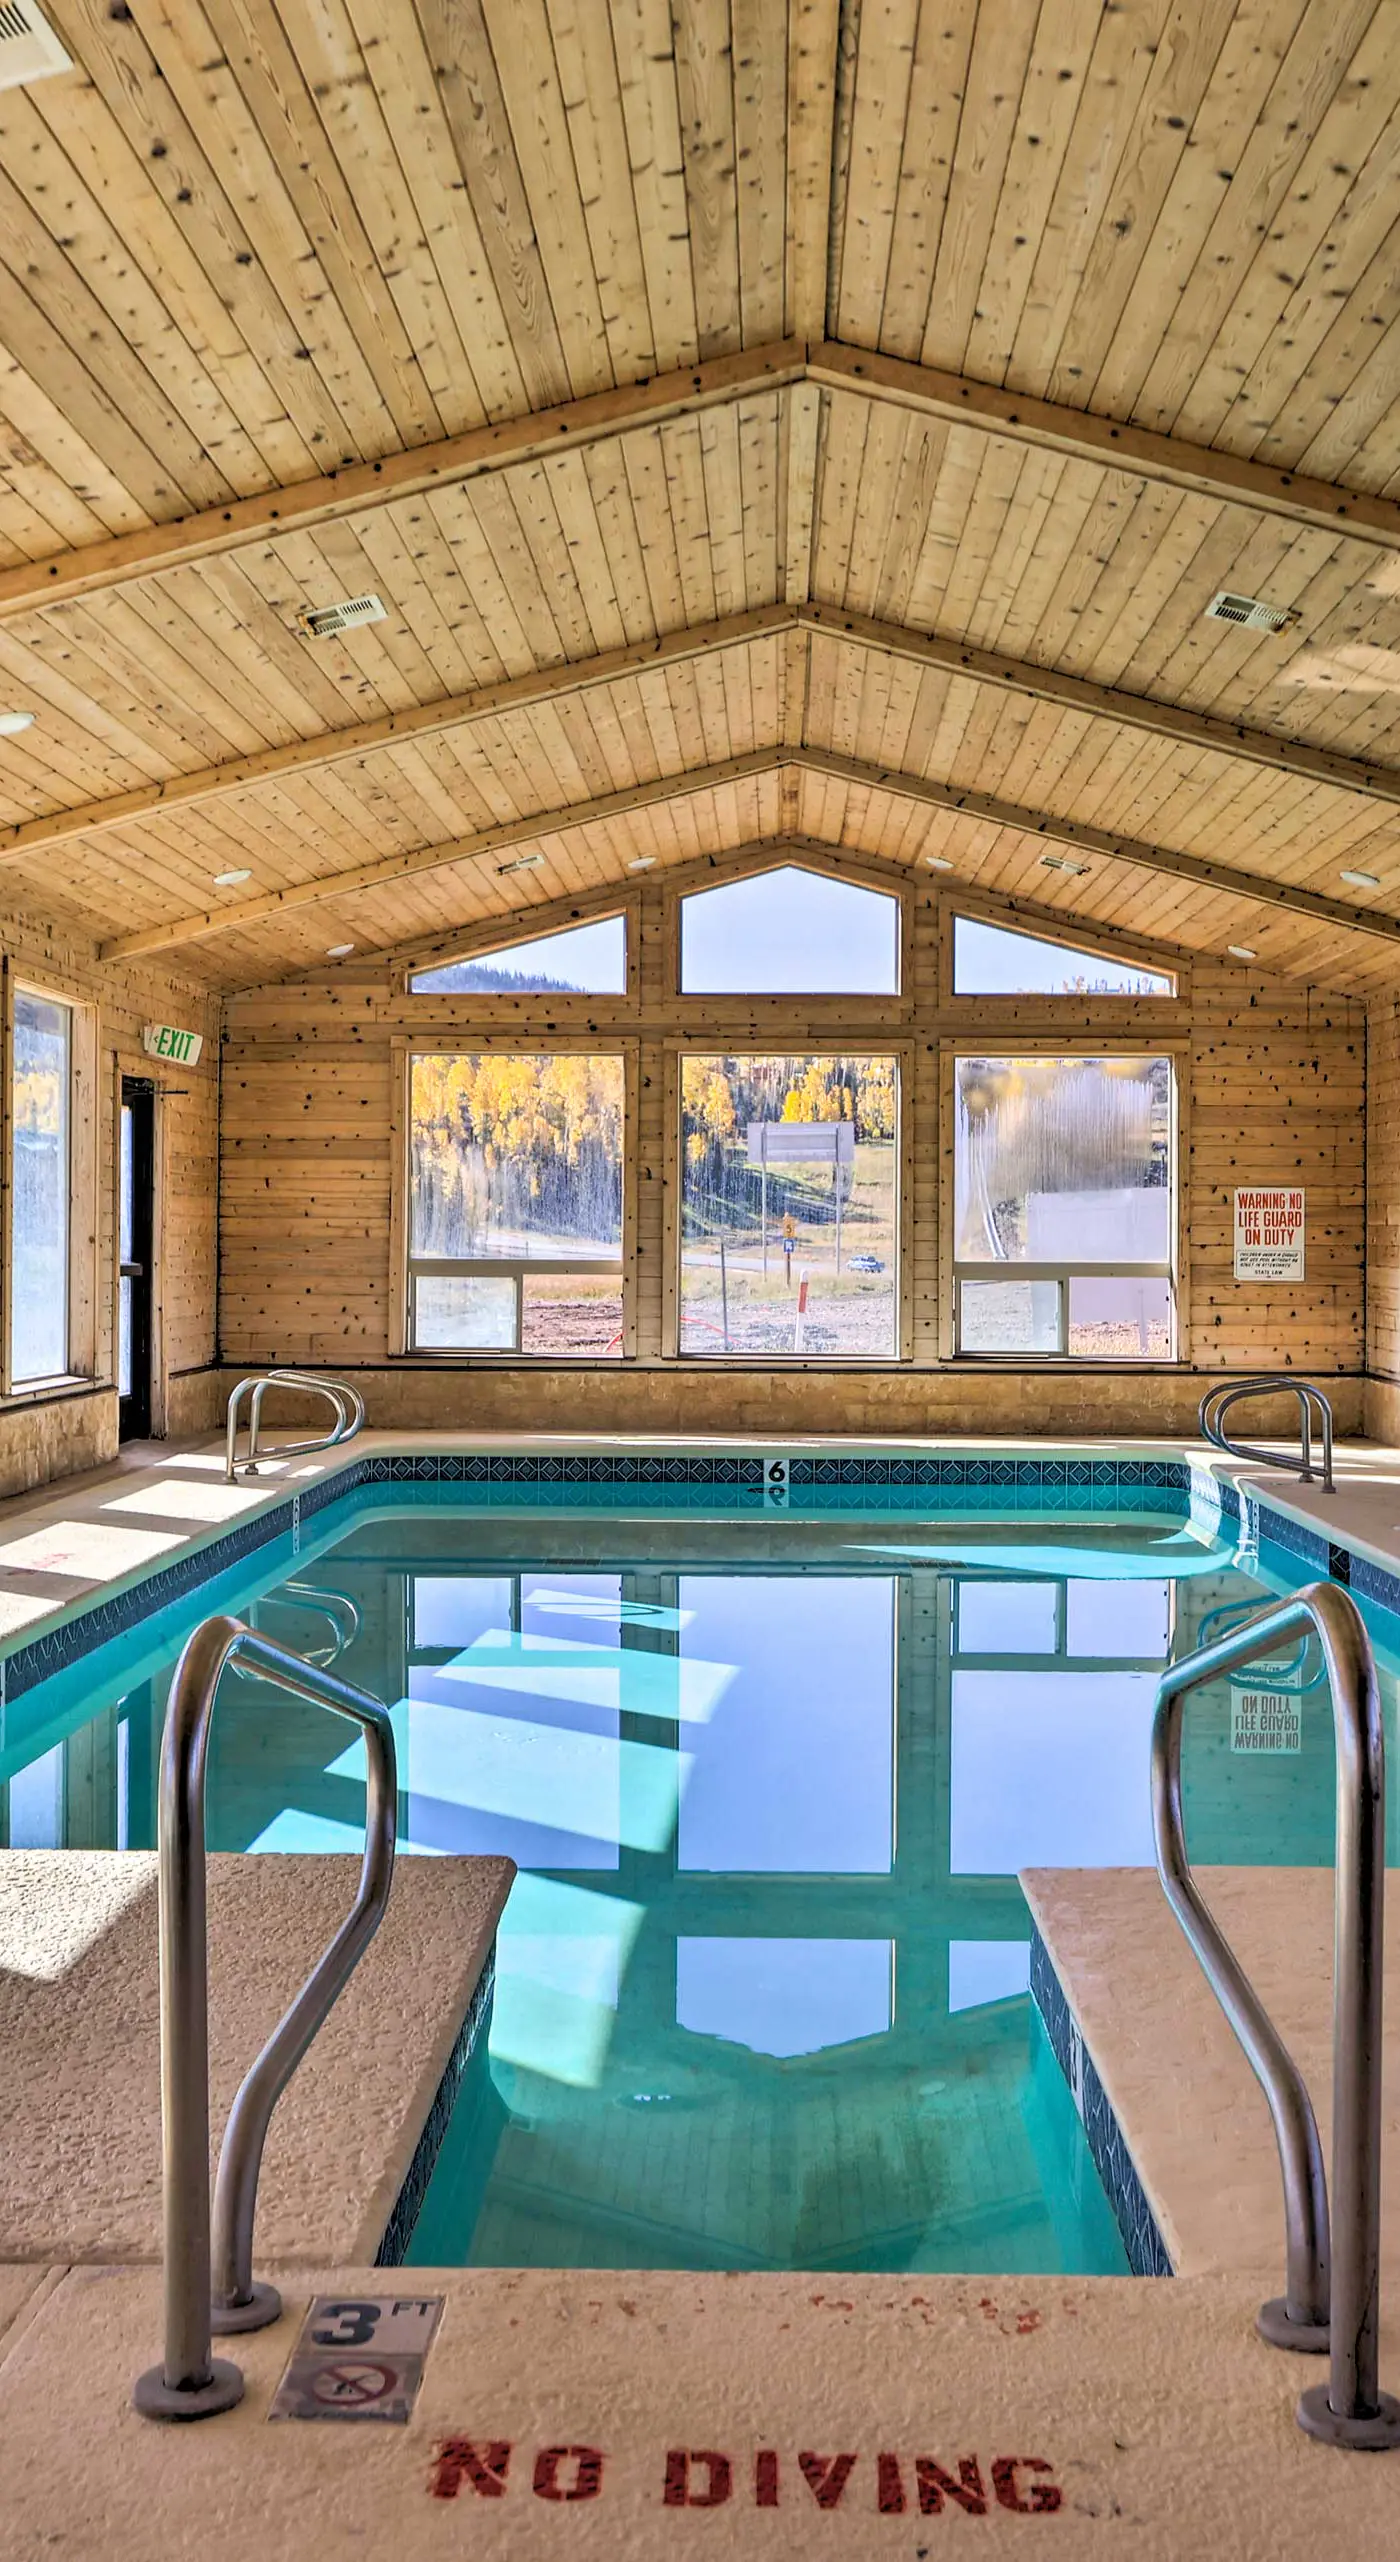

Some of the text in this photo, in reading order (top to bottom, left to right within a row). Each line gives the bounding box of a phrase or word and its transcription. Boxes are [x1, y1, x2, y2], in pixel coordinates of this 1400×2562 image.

[157, 1027, 195, 1061] EXIT
[1238, 1193, 1302, 1210] WARNING NO
[1238, 1211, 1302, 1228] LIFE GUARD
[1245, 1229, 1294, 1246] ON DUTY
[768, 1461, 786, 1482] 6
[311, 2301, 435, 2346] 3 FT
[431, 2438, 1063, 2515] NO DIVING
